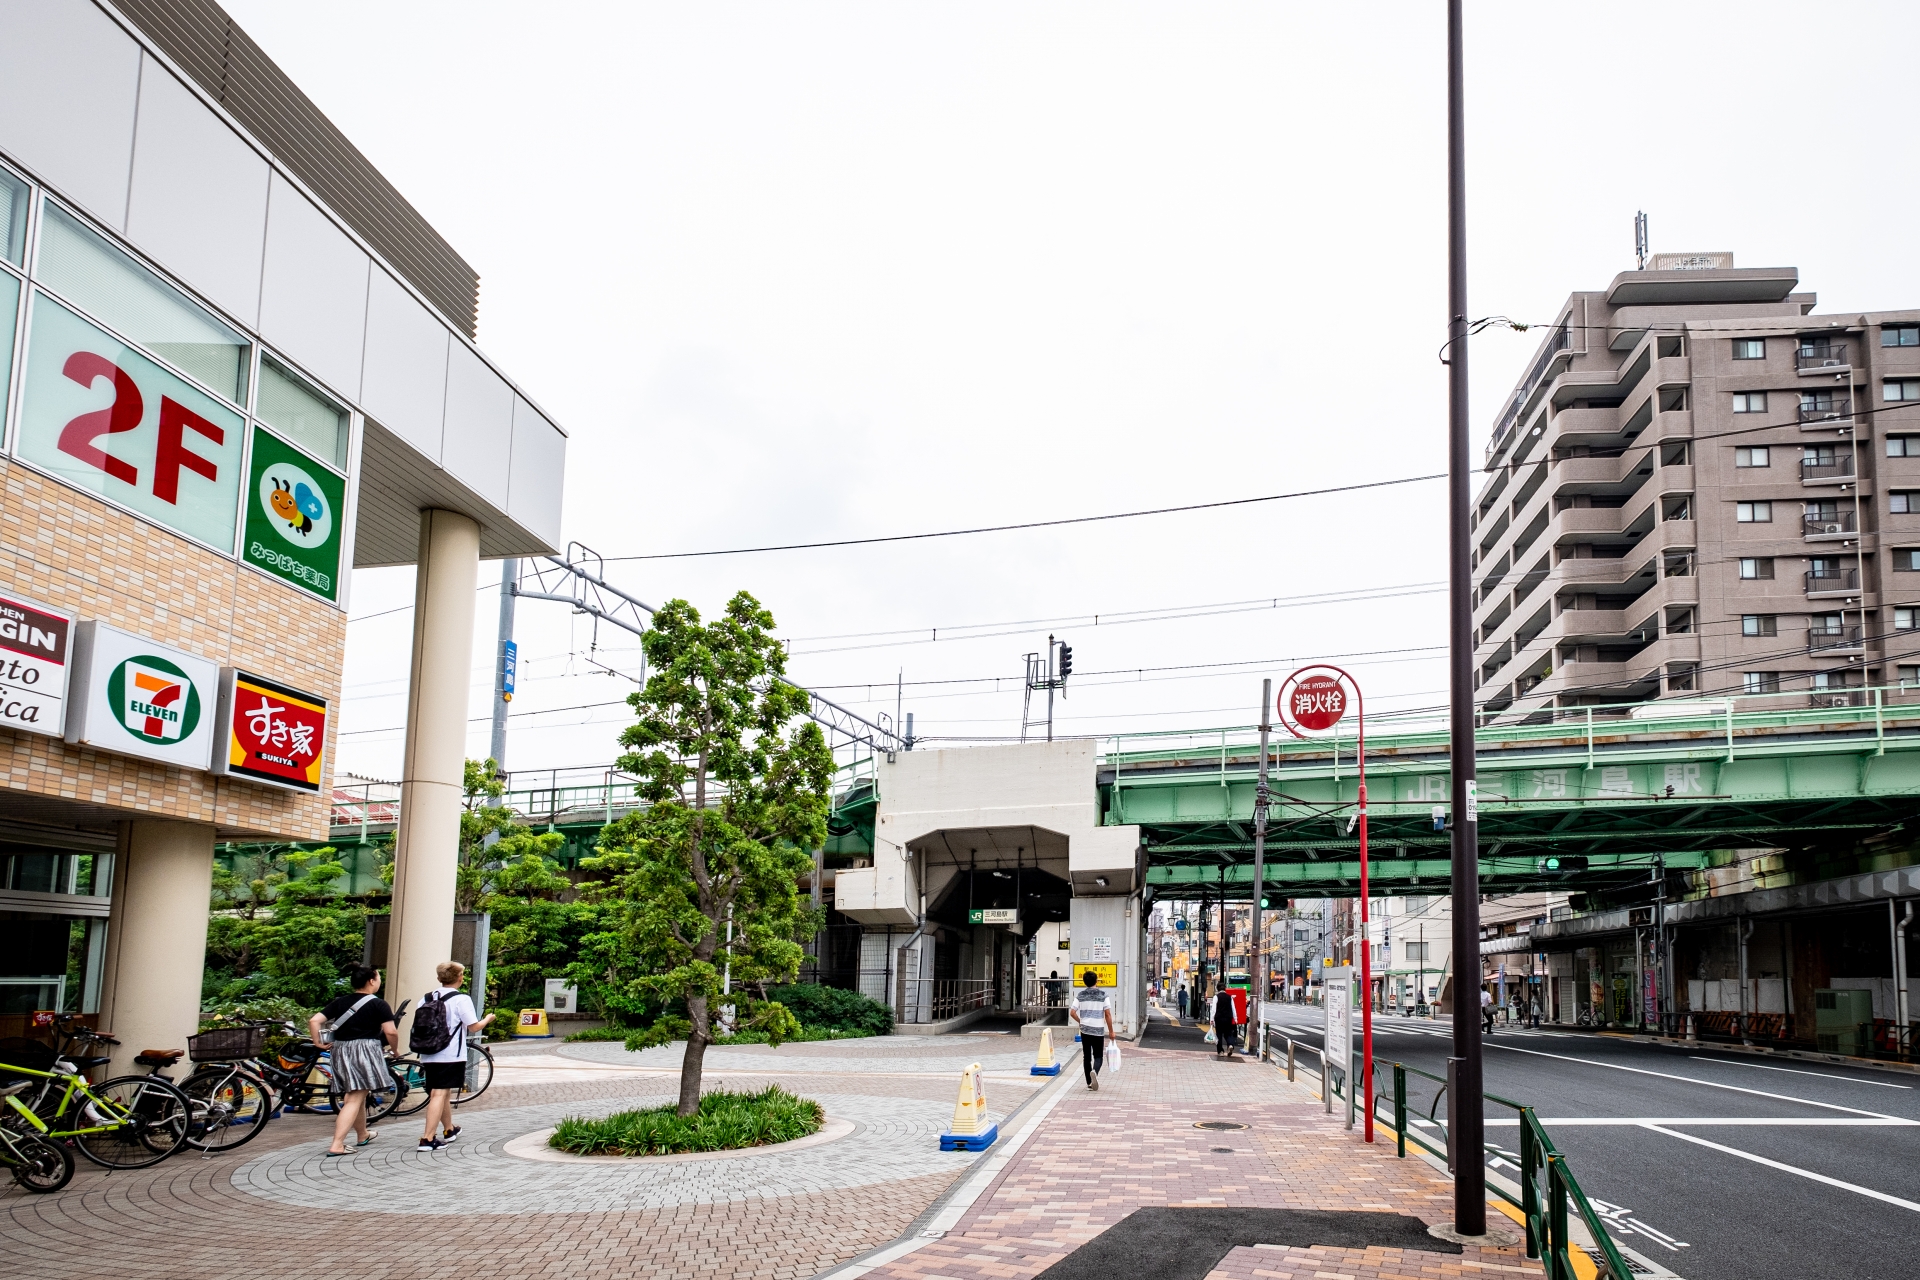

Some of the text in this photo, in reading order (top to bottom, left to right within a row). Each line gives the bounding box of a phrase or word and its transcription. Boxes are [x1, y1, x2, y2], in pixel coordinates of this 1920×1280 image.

[57, 351, 225, 506] 2F
[1312, 681, 1337, 690] HYDRANT
[1295, 690, 1342, 715] 消火栓
[245, 696, 315, 757] すき家
[261, 752, 293, 767] SUKIYA
